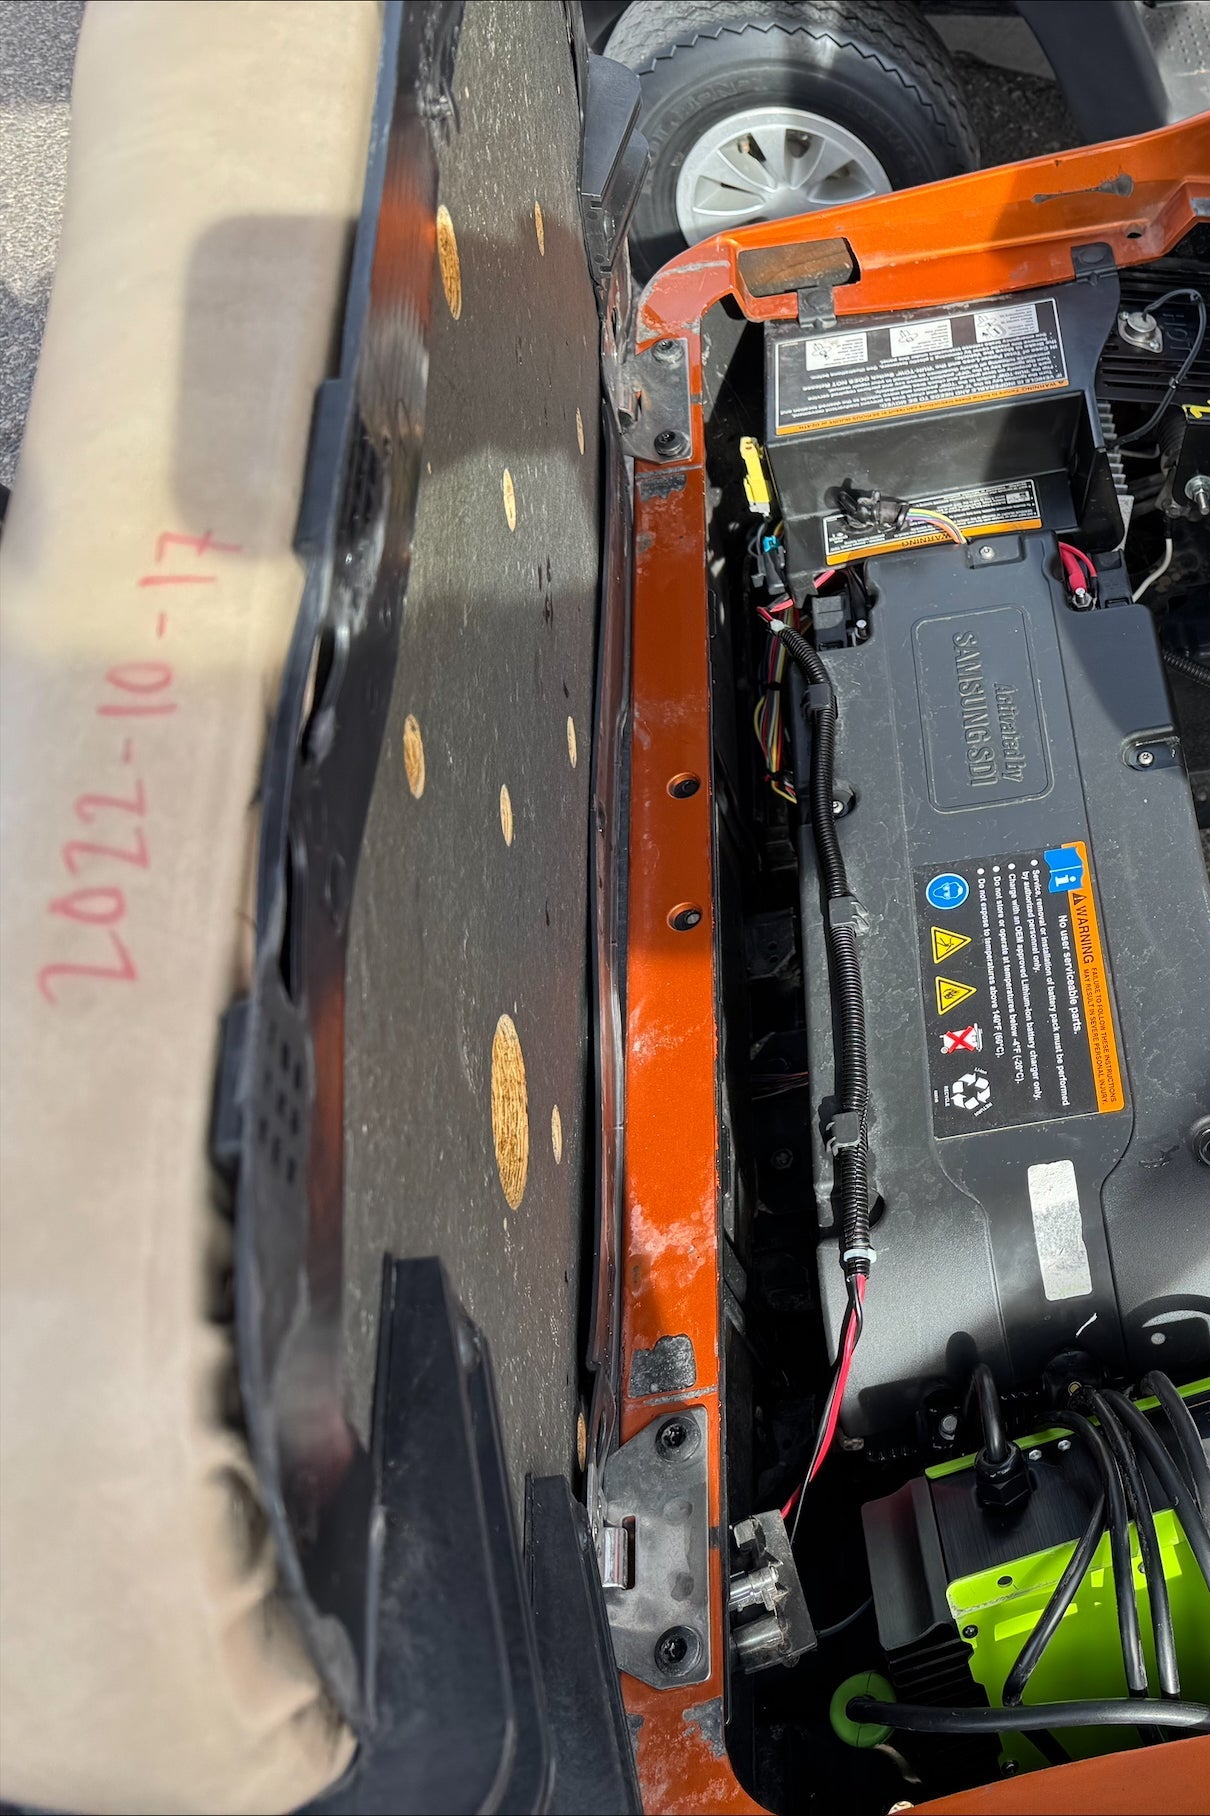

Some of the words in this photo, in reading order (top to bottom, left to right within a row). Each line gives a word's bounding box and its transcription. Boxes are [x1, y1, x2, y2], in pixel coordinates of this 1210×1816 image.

[952, 630, 993, 743] SAMSUNG
[993, 682, 1026, 761] Activated
[35, 528, 243, 1006] 2022-10-17
[966, 746, 999, 788] SDI
[1002, 761, 1027, 783] by
[977, 878, 986, 888] Do
[993, 876, 1001, 886] Do
[1007, 873, 1018, 898] Charge
[1021, 870, 1030, 880] by
[1031, 869, 1043, 897] Service,
[978, 889, 987, 901] not
[994, 887, 1003, 899] not
[1022, 881, 1034, 917] authorized
[979, 902, 990, 927] expose
[995, 900, 1005, 917] store
[1010, 899, 1020, 914] with
[1035, 898, 1046, 926] removal
[998, 919, 1006, 927] or
[1012, 915, 1021, 924] an
[1039, 927, 1047, 935] or
[1058, 914, 1068, 928] No
[982, 928, 991, 936] to
[999, 928, 1009, 955] operate
[1013, 925, 1023, 943] OEM
[1027, 918, 1039, 954] personnel
[1060, 929, 1071, 950] user
[1076, 905, 1094, 963] WARNING
[983, 937, 996, 984] temperatures
[1015, 943, 1027, 977] approved
[1031, 954, 1041, 972] only.
[1040, 936, 1053, 976] installation
[1003, 964, 1015, 1012] temperatures
[1045, 976, 1054, 985] of
[1063, 952, 1079, 1004] serviceable
[1092, 967, 1100, 992] FAILURE
[988, 985, 999, 1008] above
[1046, 985, 1057, 1012] battery
[1085, 983, 1094, 1007] RESULT
[1096, 994, 1102, 1003] TO
[991, 1009, 1001, 1030] 140°F
[1008, 1013, 1018, 1036] below
[1049, 1013, 1060, 1031] pack
[1070, 1006, 1083, 1034] parts.
[1090, 1016, 1099, 1041] SEVERE
[1097, 1004, 1106, 1030] FOLLOW
[1011, 1038, 1020, 1054] -4°F
[1024, 1021, 1036, 1049] battery
[1052, 1032, 1062, 1052] must
[1101, 1032, 1109, 1052] THESE
[1028, 1050, 1040, 1080] charger
[1054, 1053, 1064, 1063] be
[1094, 1043, 1104, 1077] PERSONAL
[1031, 1080, 1042, 1100] only.
[1056, 1064, 1069, 1106] performed
[1104, 1054, 1116, 1102] INSTRUCTIONS
[1099, 1079, 1107, 1104] INJURY.
[974, 1102, 992, 1116] RETURN
